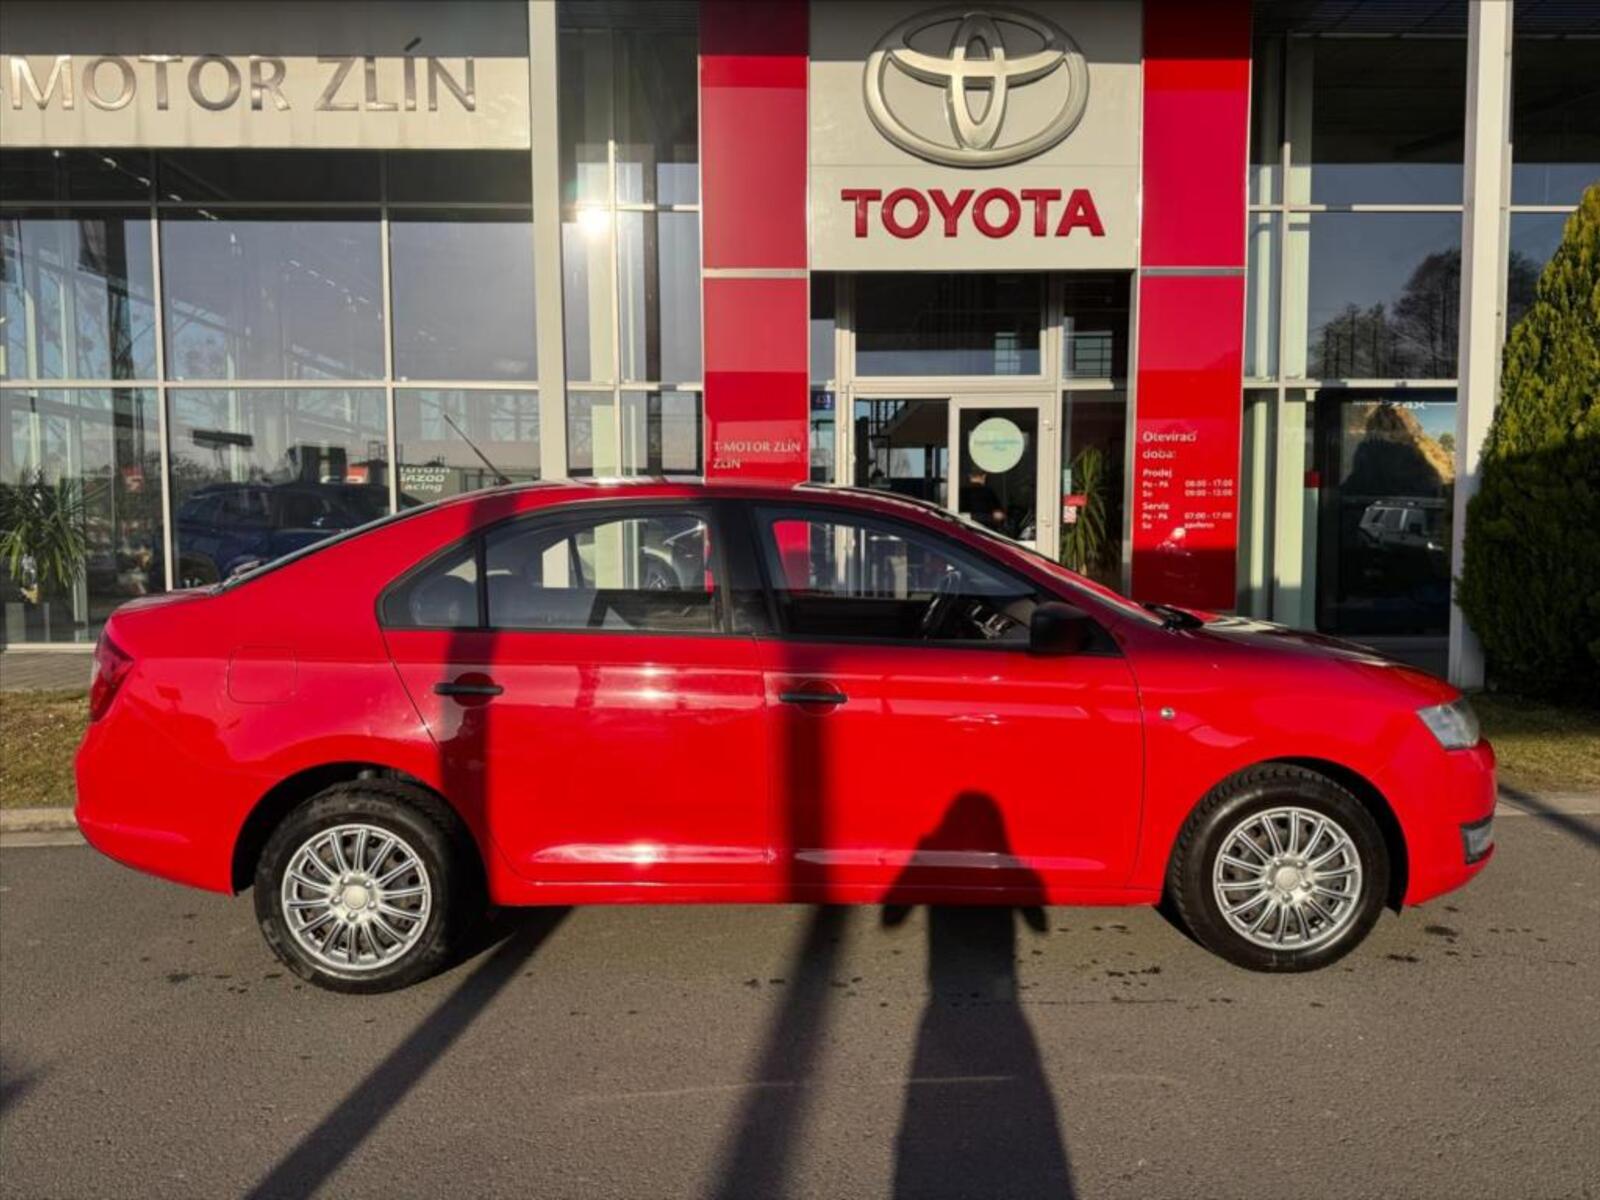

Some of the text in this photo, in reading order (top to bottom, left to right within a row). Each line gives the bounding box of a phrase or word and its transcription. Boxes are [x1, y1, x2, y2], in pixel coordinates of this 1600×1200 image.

[315, 37, 476, 112] ZLÍN
[841, 187, 1106, 239] TOYOTA
[713, 438, 801, 453] T-MOTOR ZLÍN
[403, 482, 442, 493] acing
